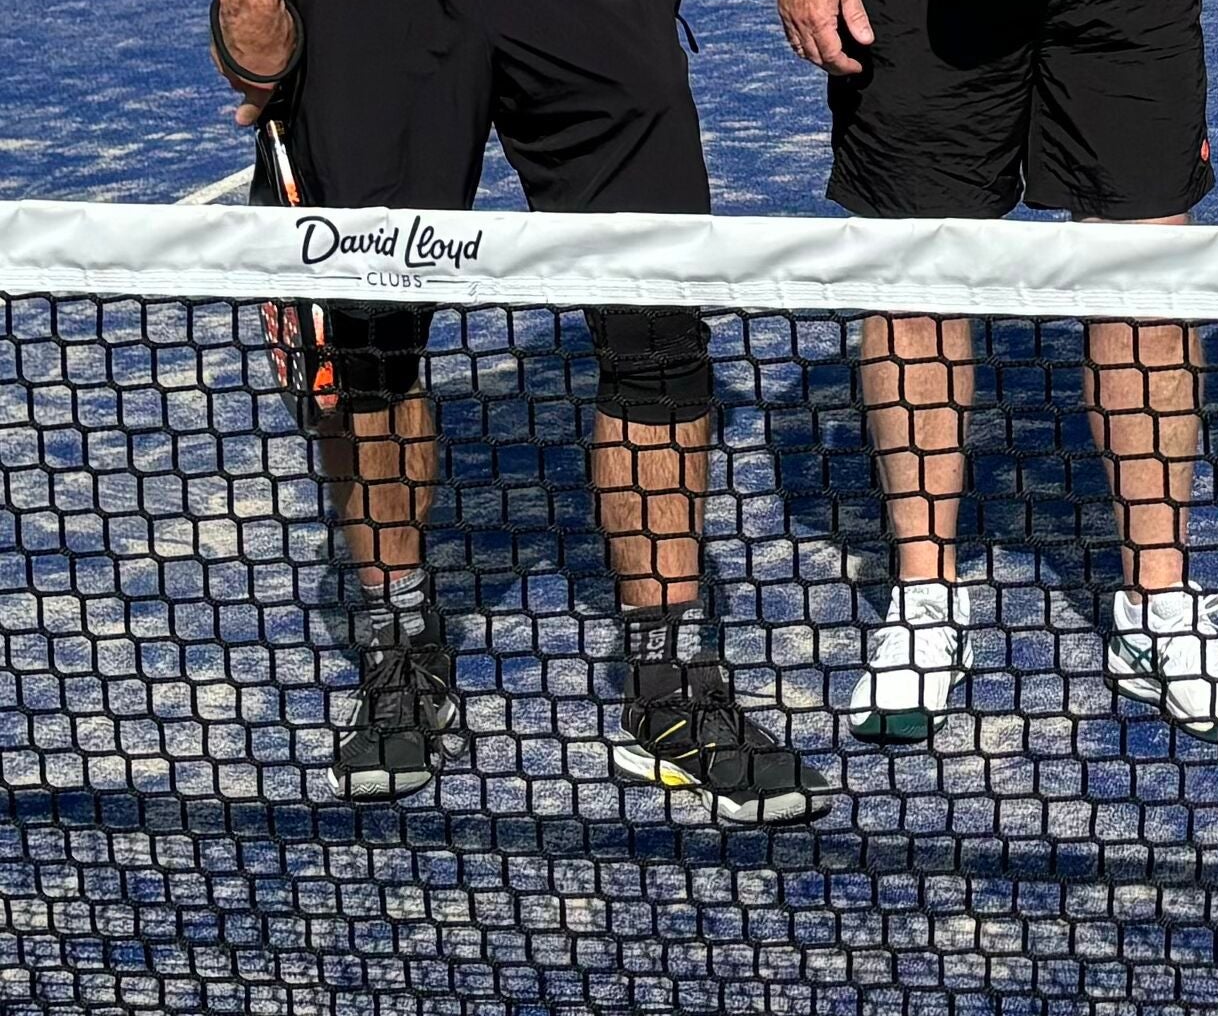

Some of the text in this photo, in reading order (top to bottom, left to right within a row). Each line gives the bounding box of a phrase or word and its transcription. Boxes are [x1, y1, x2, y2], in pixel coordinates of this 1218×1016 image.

[296, 215, 483, 269] David Lloyd
[366, 272, 423, 289] CLUBS
